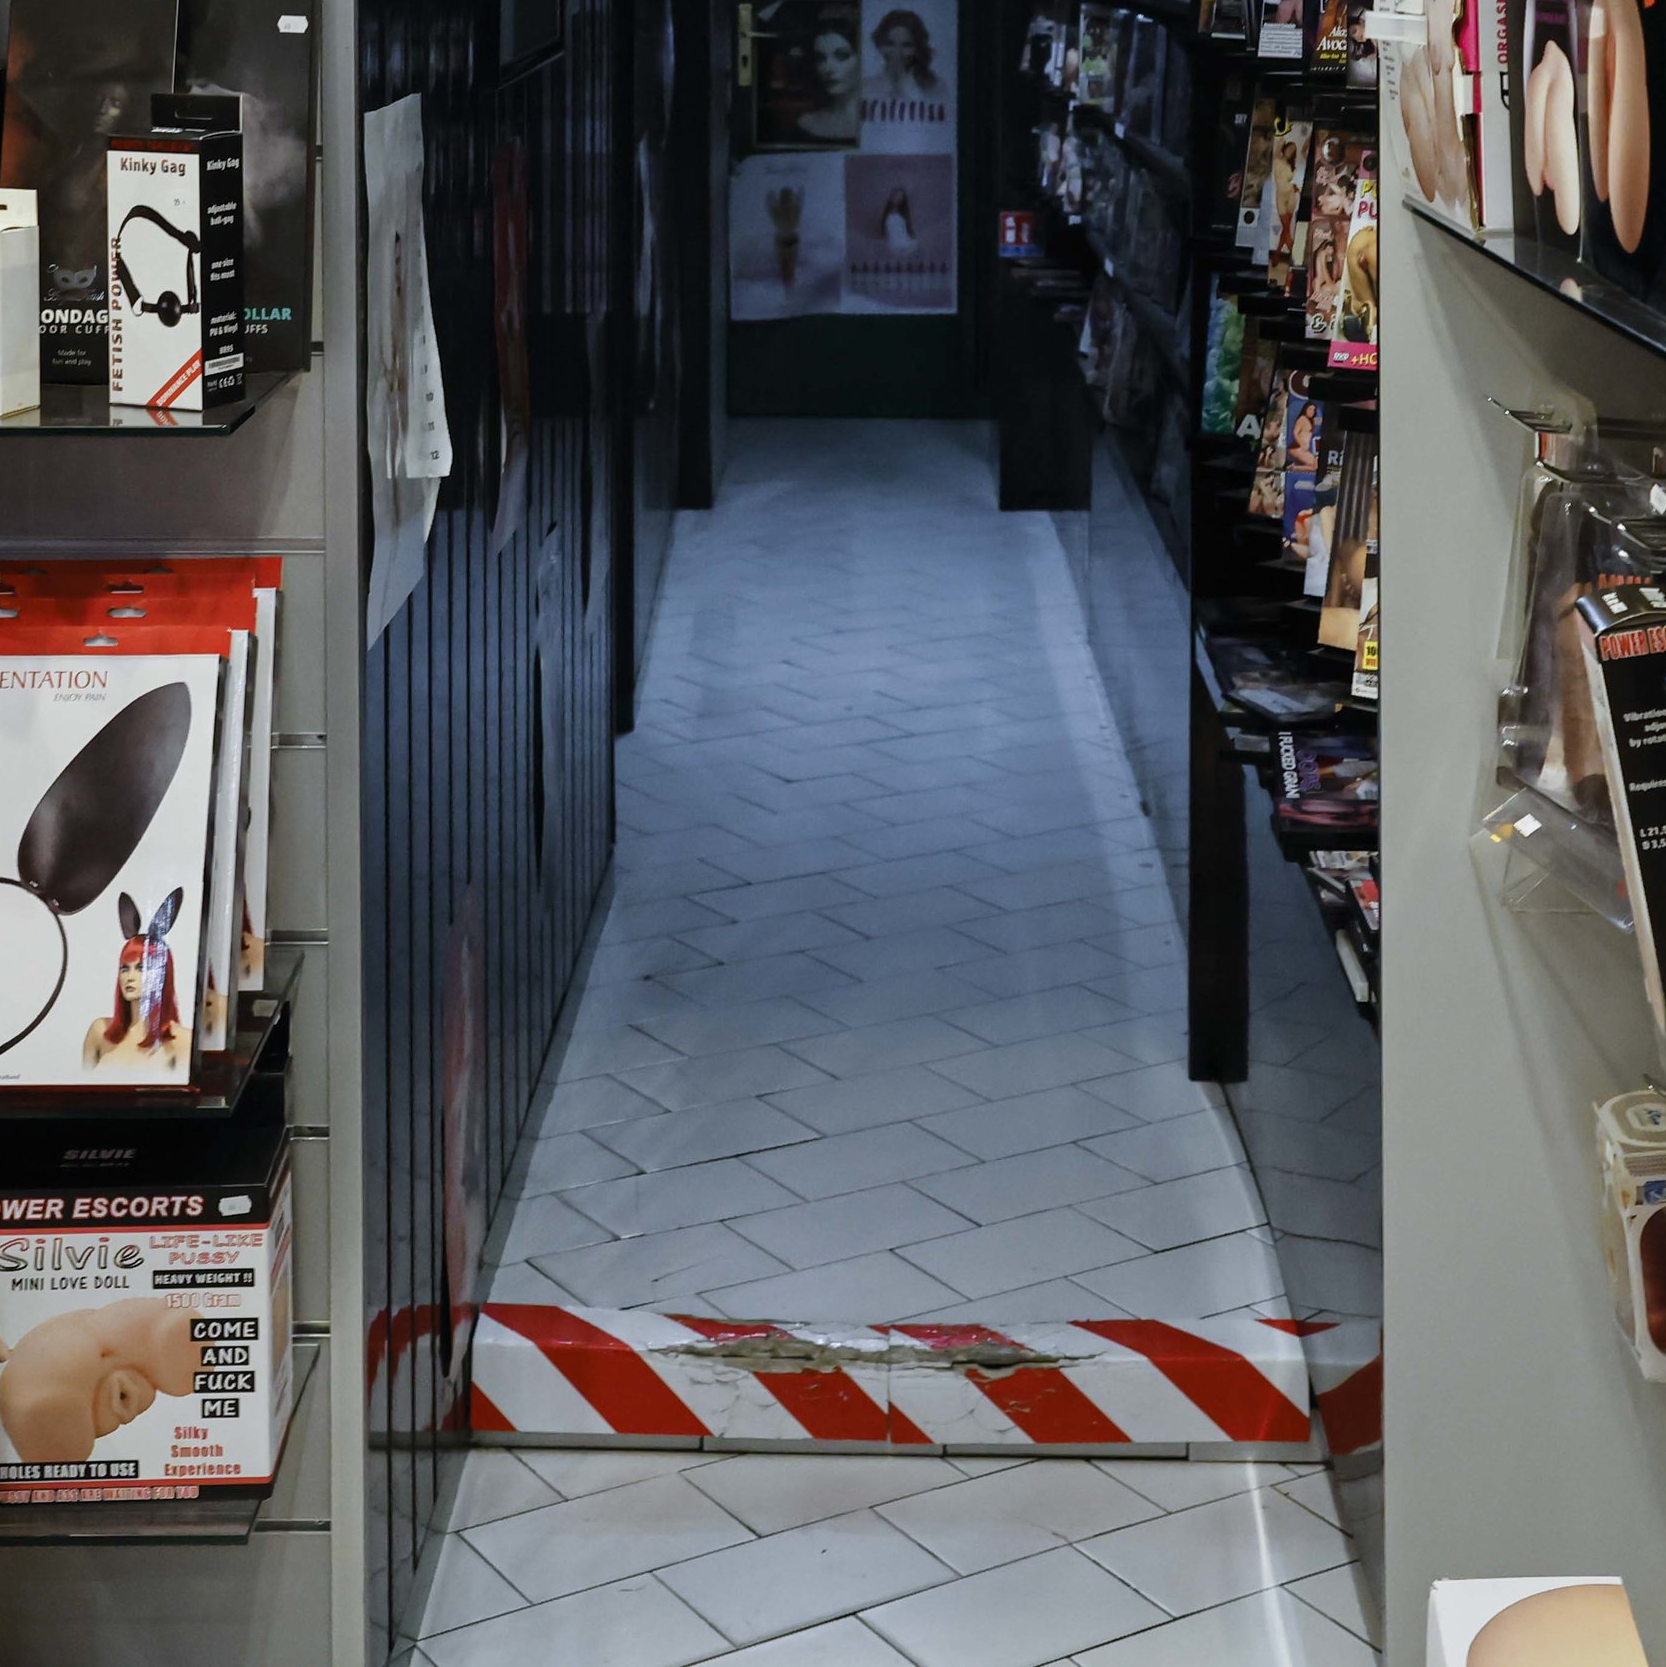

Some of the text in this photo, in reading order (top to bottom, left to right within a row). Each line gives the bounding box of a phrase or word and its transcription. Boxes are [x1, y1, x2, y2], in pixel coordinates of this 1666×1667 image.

[121, 157, 187, 177] Kinky Gag
[206, 157, 240, 171] Kinky Gag
[40, 309, 110, 324] ONDAG
[110, 236, 123, 392] FETISH POWER
[1599, 630, 1647, 661] POWER
[63, 1148, 138, 1160] SILVIE
[71, 1194, 205, 1220] ESCORTS
[148, 1232, 264, 1250] LIFE-LIKE
[168, 1250, 241, 1266] PUSSY
[11, 1274, 131, 1292] MINI LOVE DOLL
[155, 1270, 240, 1287] HEAVY WEIGHT
[192, 1321, 257, 1339] COME
[201, 1349, 248, 1366] AND
[194, 1373, 253, 1391] FUCK
[204, 1399, 238, 1417] ME
[174, 1426, 209, 1441] Silky
[170, 1443, 224, 1458] Smooth
[0, 1462, 137, 1480] HOLES READY TO USE
[164, 1462, 243, 1478] Experience
[152, 1485, 174, 1501] FOR
[175, 1485, 200, 1500] YOU
